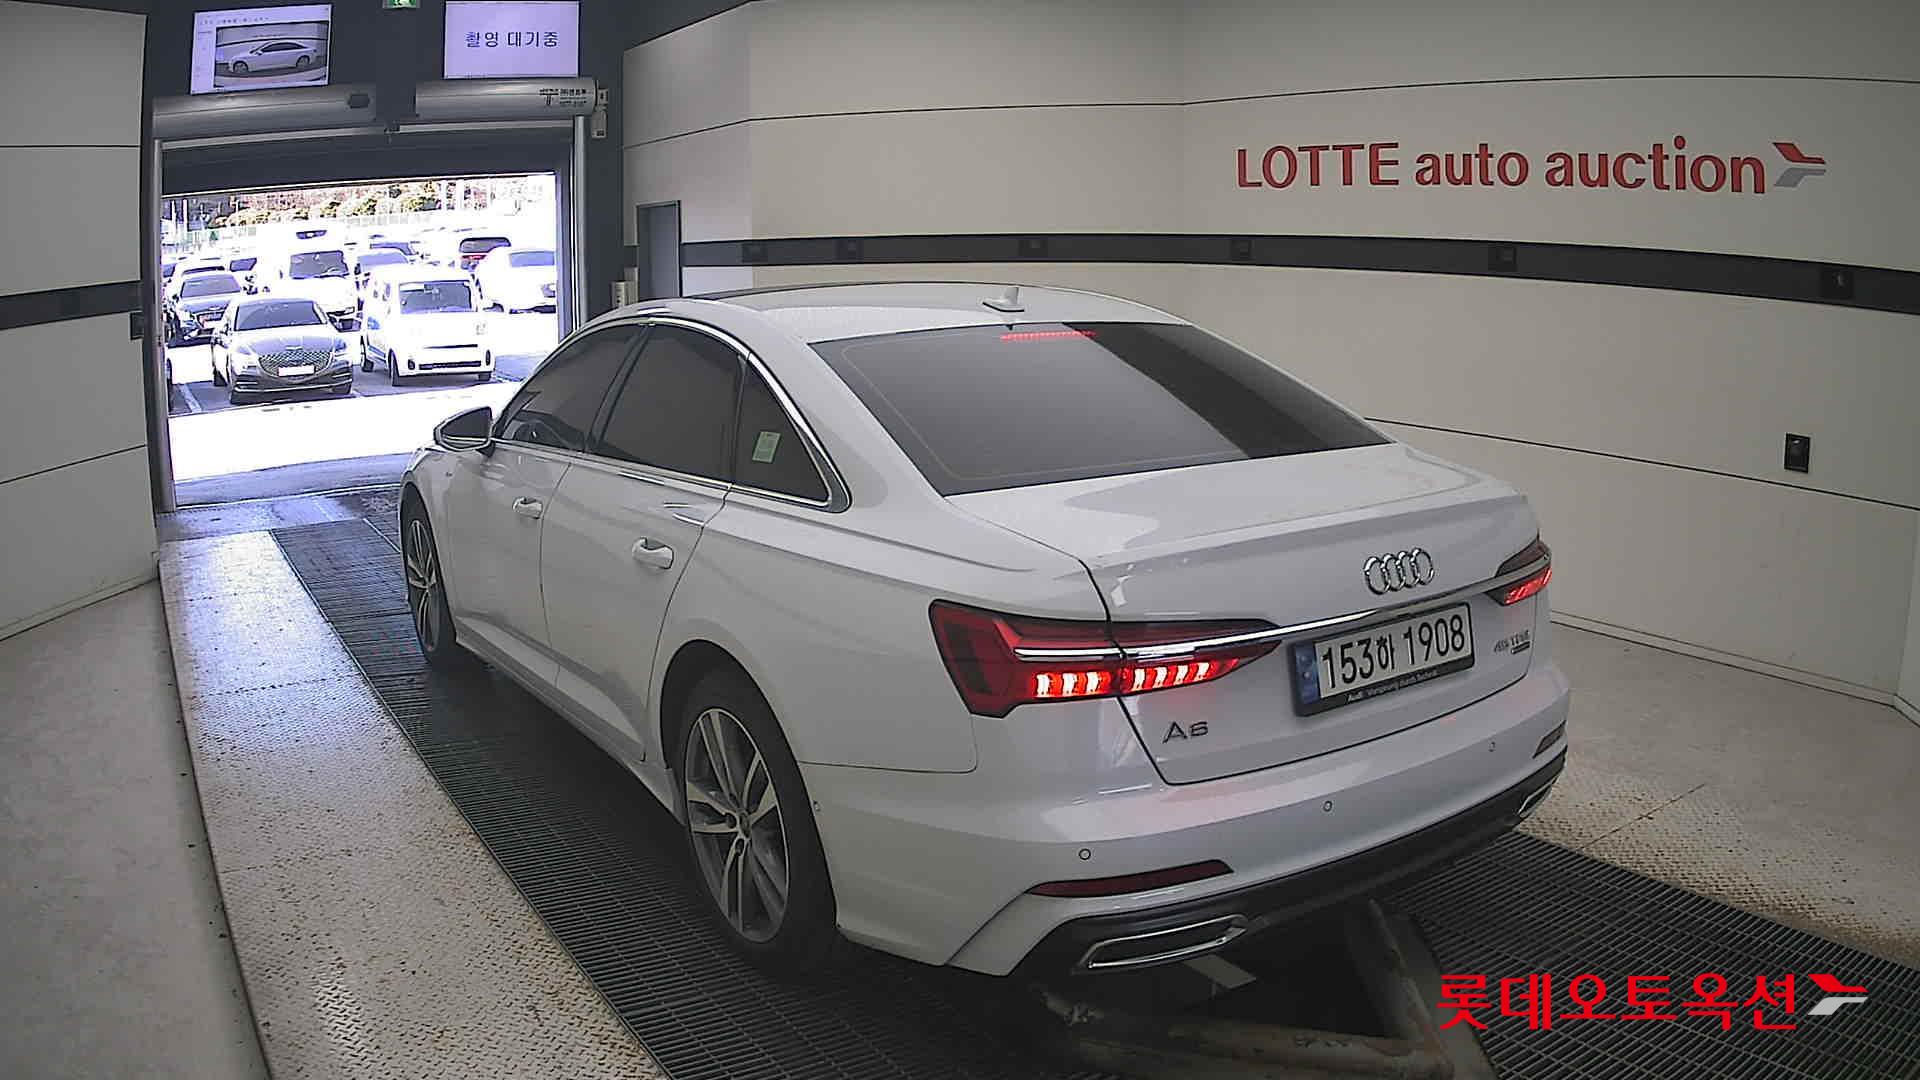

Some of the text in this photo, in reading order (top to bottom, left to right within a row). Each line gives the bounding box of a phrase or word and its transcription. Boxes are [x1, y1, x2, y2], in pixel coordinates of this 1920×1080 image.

[507, 31, 559, 48] 대기중
[1237, 135, 1766, 194] LOTTE auto auction
[1322, 633, 1395, 689] 153하
[1402, 614, 1465, 666] 1908
[1162, 721, 1208, 744] A6
